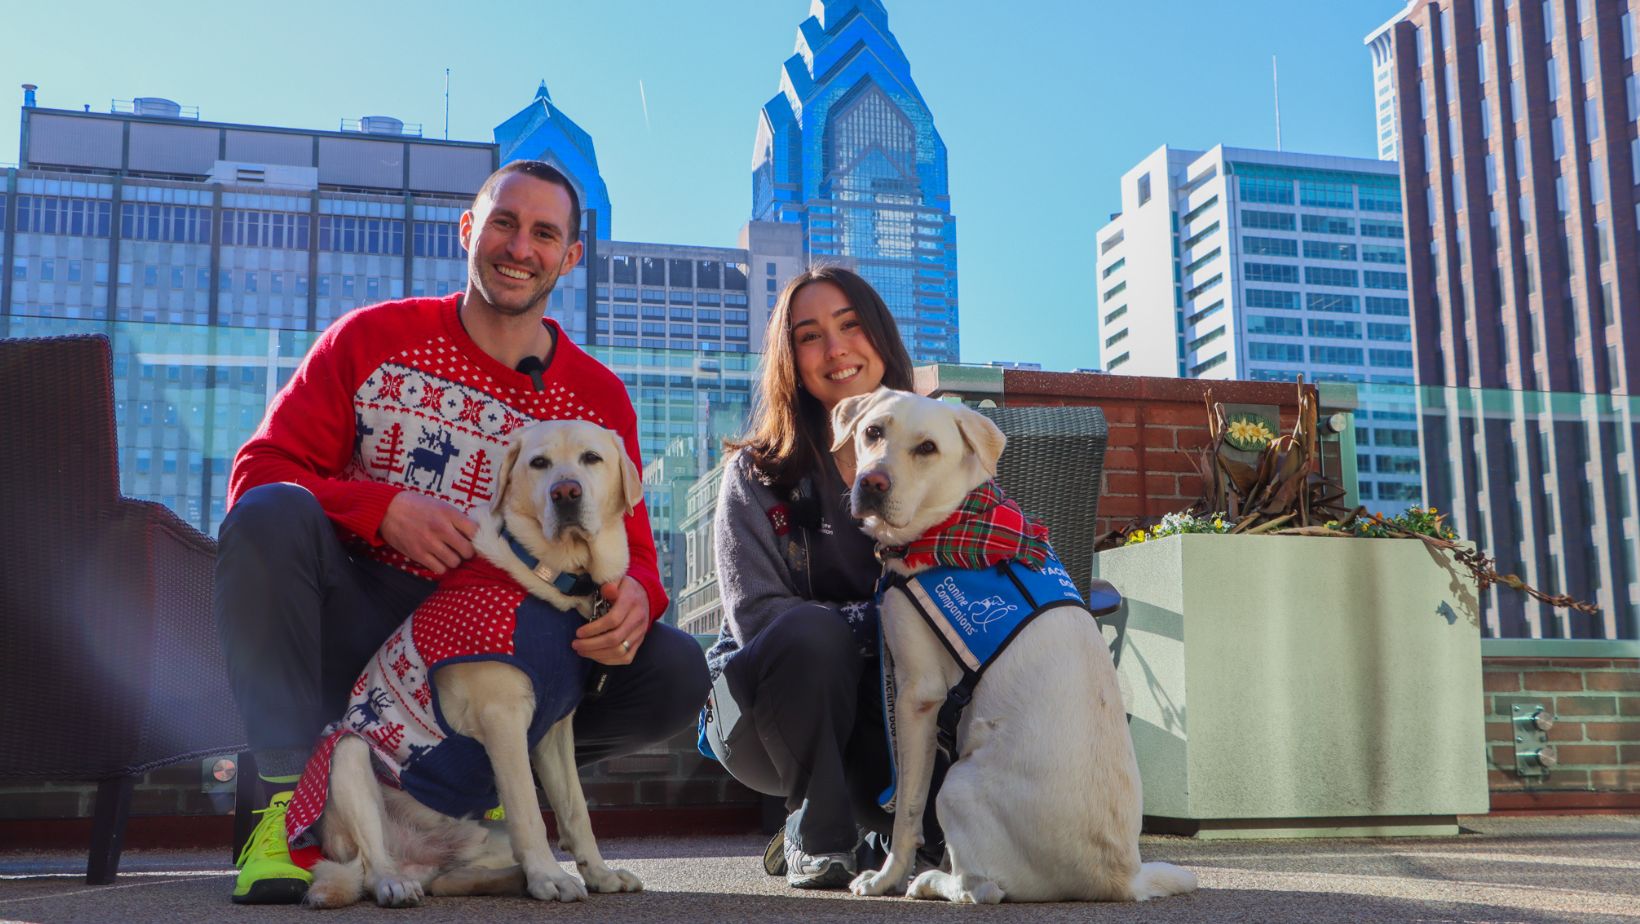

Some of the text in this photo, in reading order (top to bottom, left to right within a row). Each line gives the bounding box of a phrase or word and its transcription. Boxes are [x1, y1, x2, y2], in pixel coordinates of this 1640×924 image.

[944, 576, 968, 607] Canine
[935, 583, 974, 636] Companions
[886, 675, 895, 713] FACILITY
[889, 715, 897, 737] DOG
